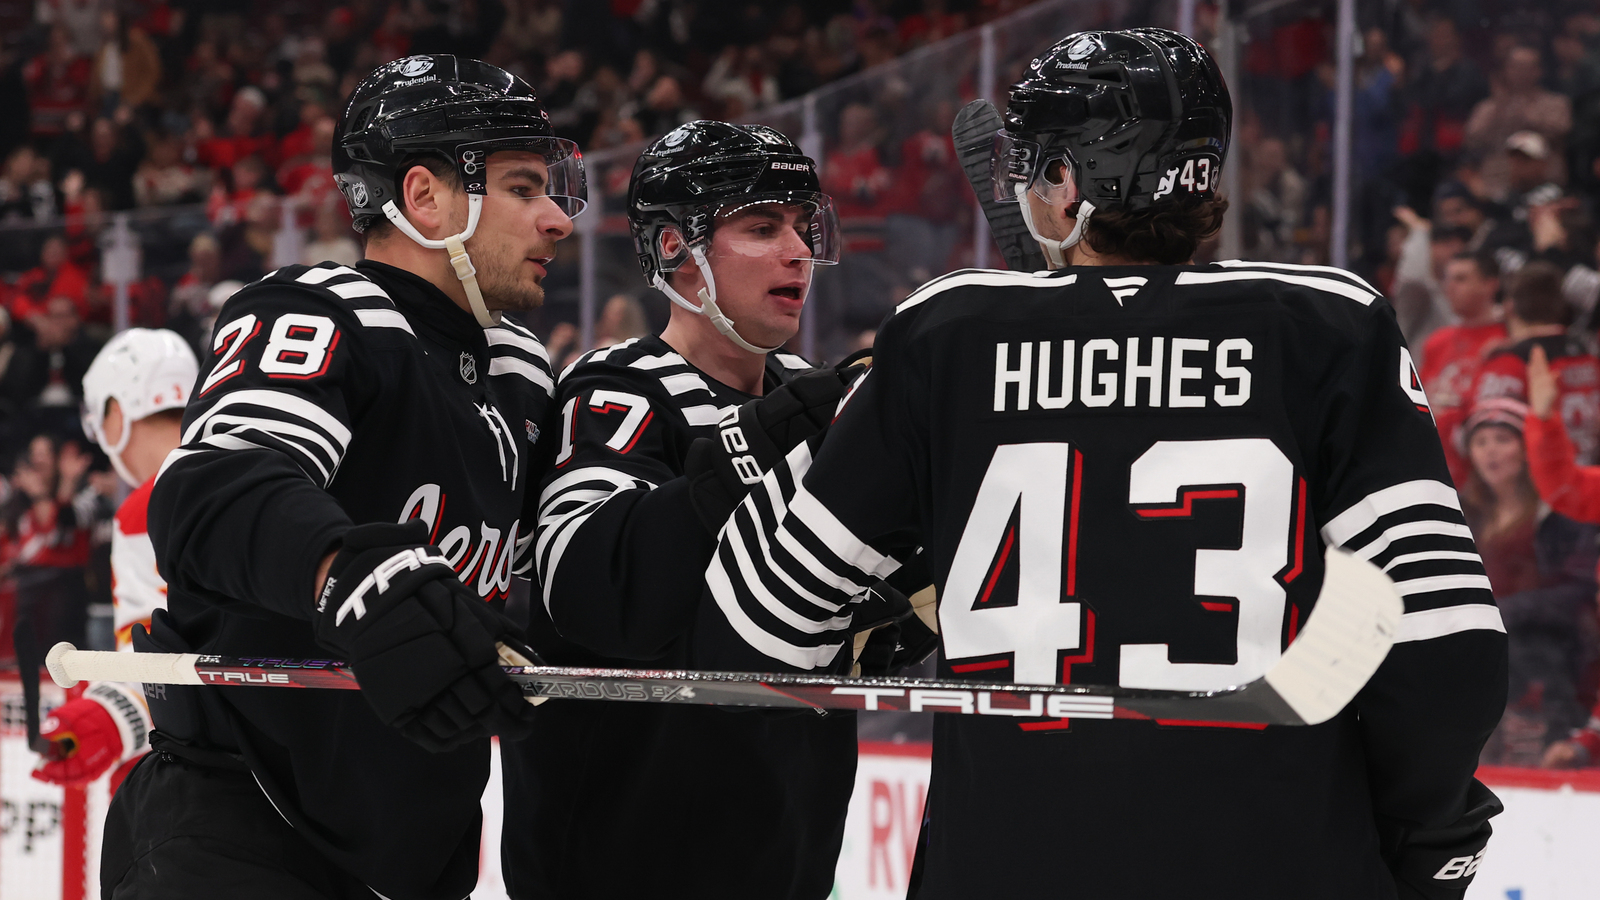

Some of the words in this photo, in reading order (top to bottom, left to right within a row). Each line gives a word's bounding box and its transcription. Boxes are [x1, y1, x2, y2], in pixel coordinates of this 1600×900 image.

[393, 74, 437, 88] Prudential
[1055, 61, 1089, 70] Prudential
[1180, 158, 1211, 193] 43
[199, 313, 341, 398] 28
[993, 336, 1253, 412] HUGHES
[555, 389, 654, 469] 17
[317, 576, 337, 613] MEIER
[938, 437, 1307, 731] 43
[199, 671, 289, 684] TRUE
[239, 657, 332, 669] TRUE
[831, 686, 1114, 719] TRUE
